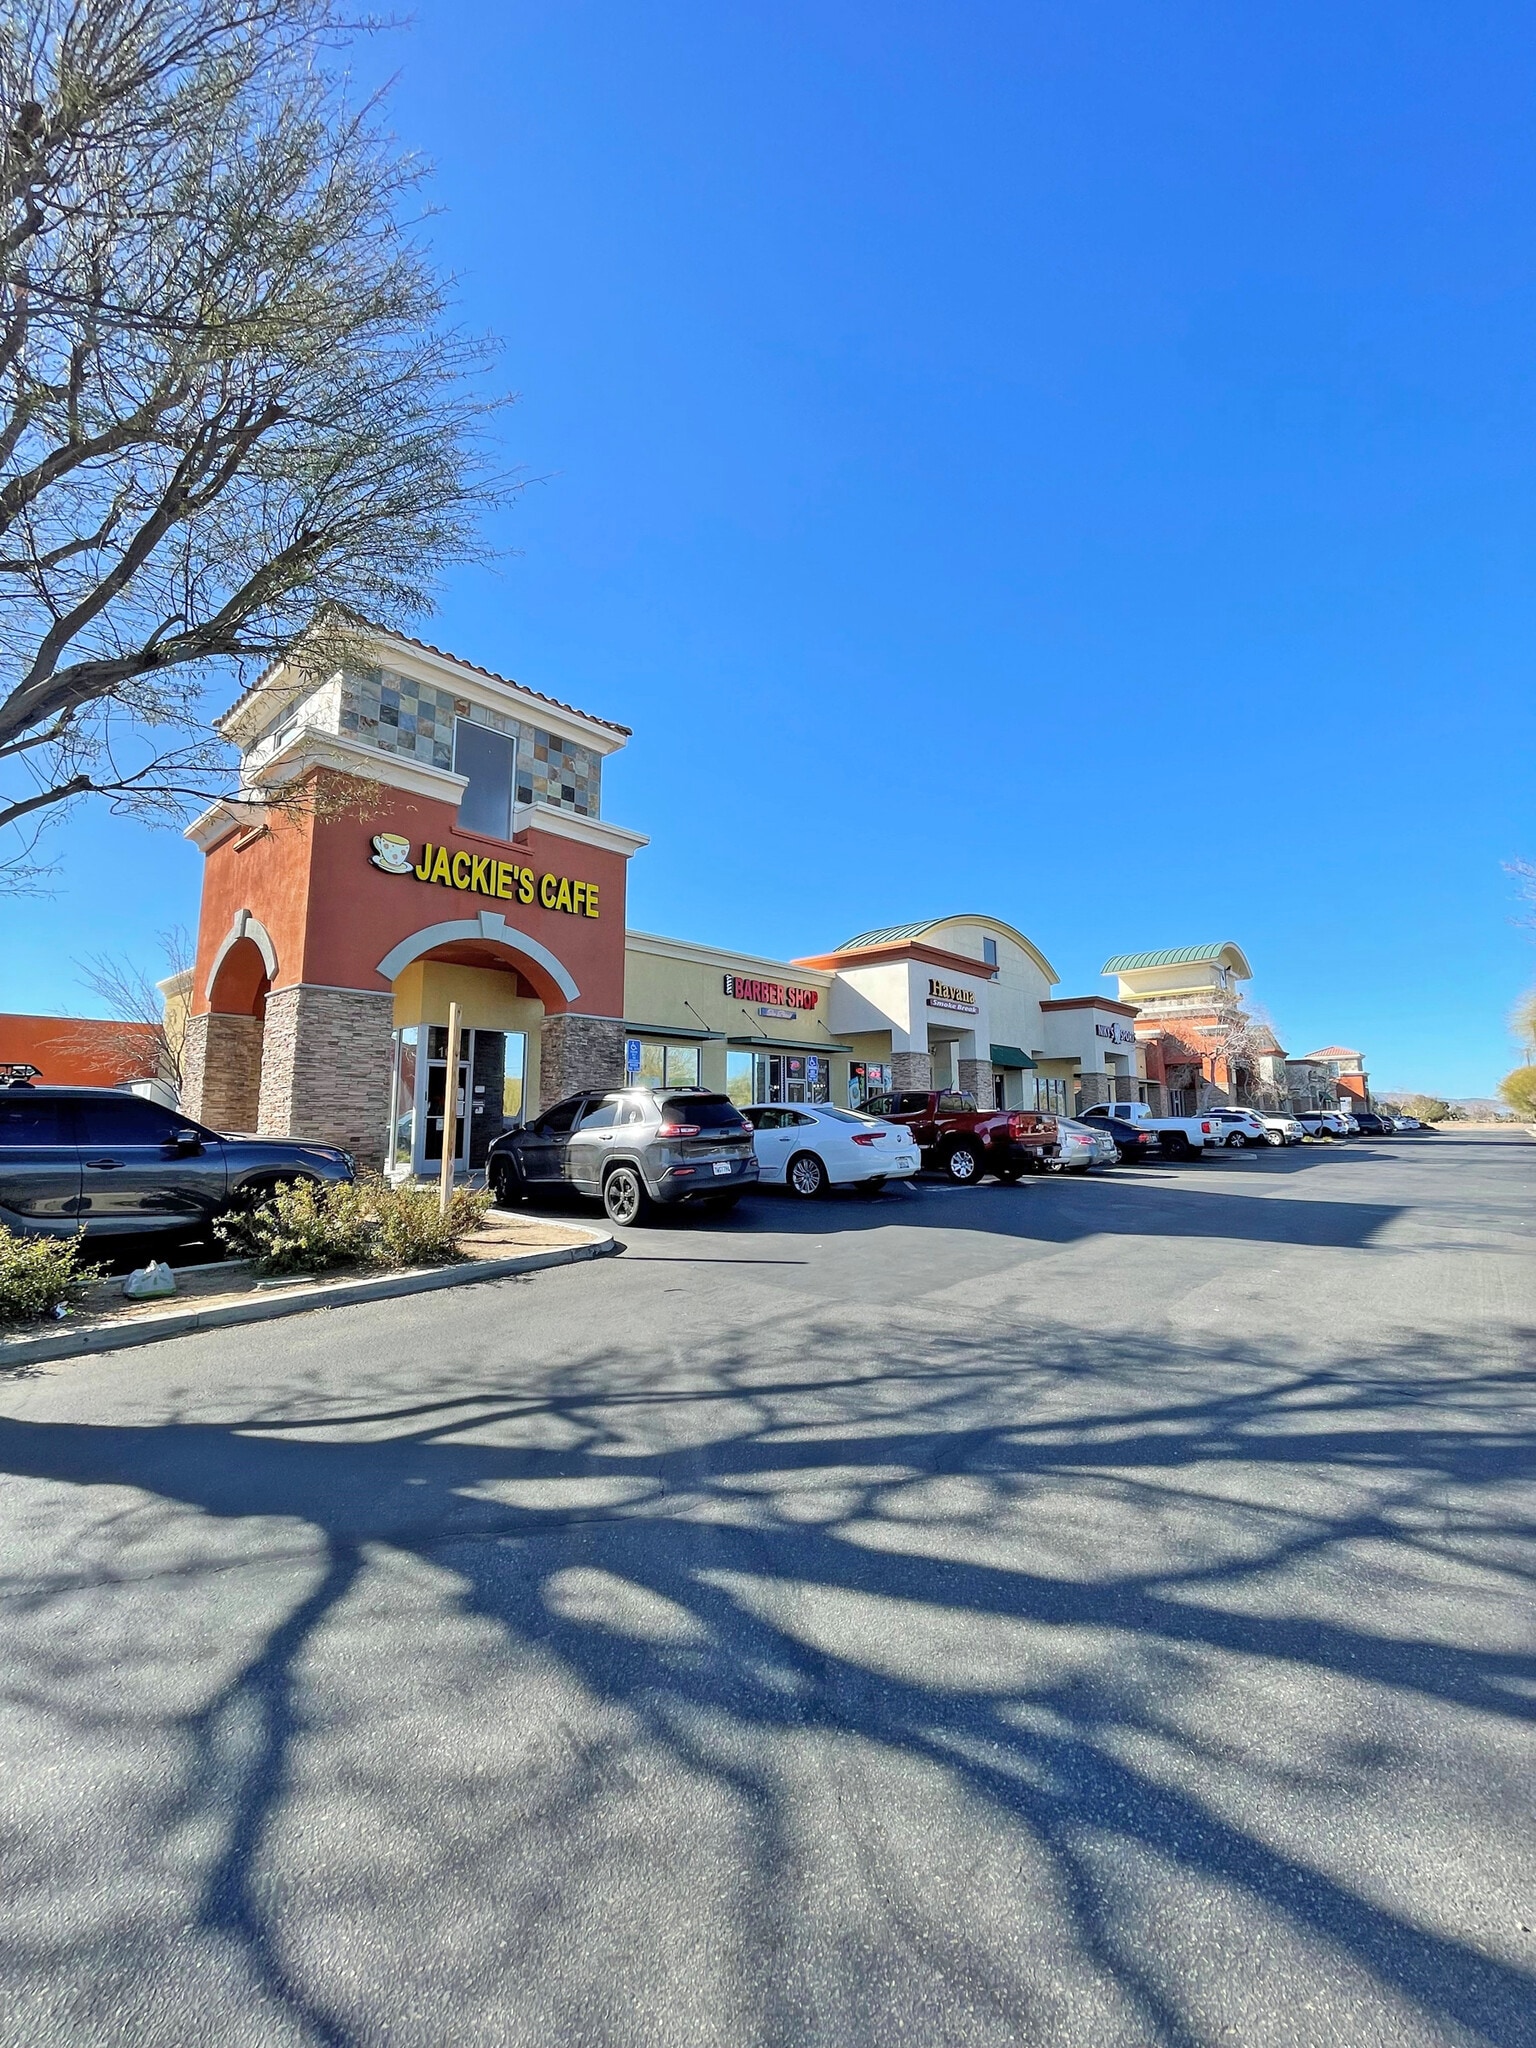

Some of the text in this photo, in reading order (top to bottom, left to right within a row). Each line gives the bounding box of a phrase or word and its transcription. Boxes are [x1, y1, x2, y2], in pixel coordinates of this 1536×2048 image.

[415, 842, 600, 919] JACKIE'S CAFE
[734, 976, 819, 1010] BARBER SHOP
[929, 978, 976, 1004] Havana
[932, 999, 978, 1013] Smoke Break
